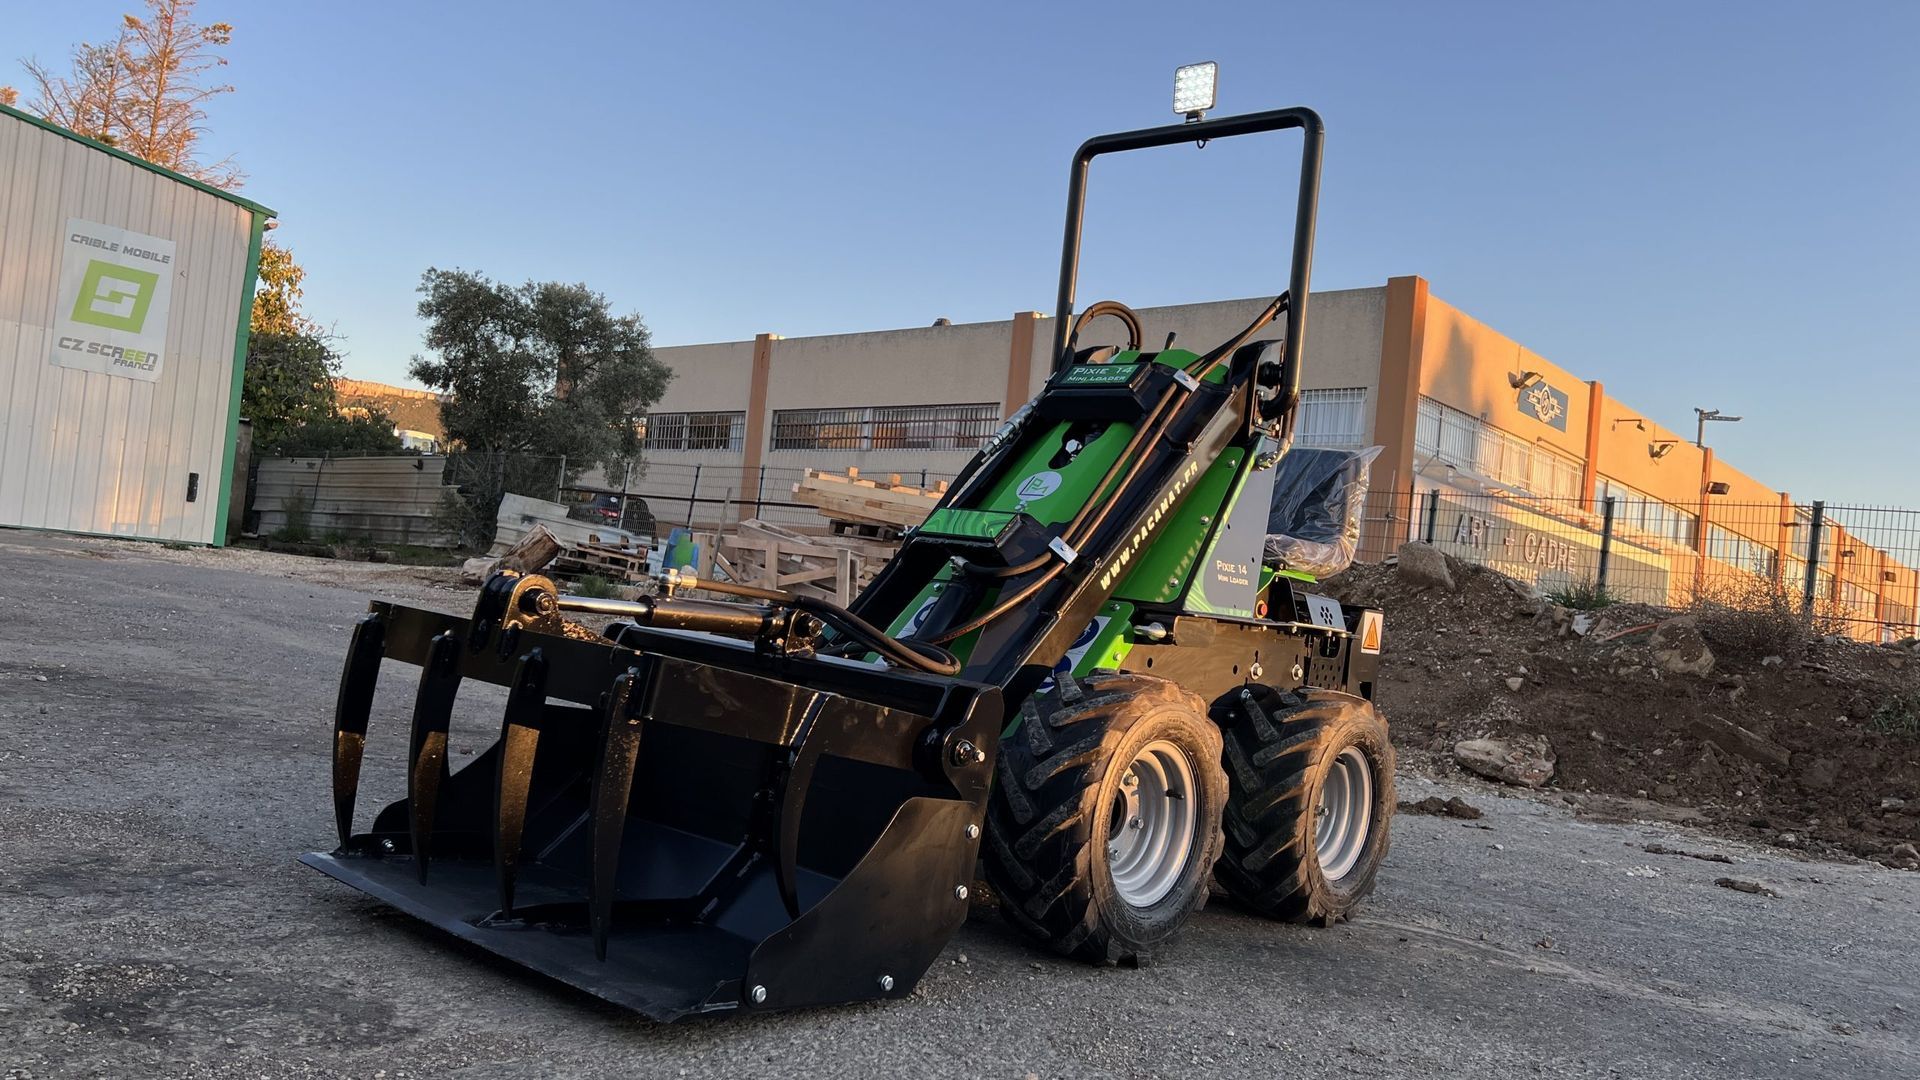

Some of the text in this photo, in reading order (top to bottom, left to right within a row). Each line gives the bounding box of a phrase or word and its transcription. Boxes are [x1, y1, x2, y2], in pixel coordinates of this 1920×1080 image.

[70, 233, 171, 264] CRIBLE MOBILE
[58, 336, 159, 365] CZ SCREEN
[113, 358, 155, 371] FRANCE
[1116, 366, 1133, 374] 14
[1100, 461, 1198, 590] WWW.PACAMAT.FR
[1456, 513, 1496, 552] ART
[1524, 532, 1578, 575] CADRE
[1238, 564, 1248, 575] 14
